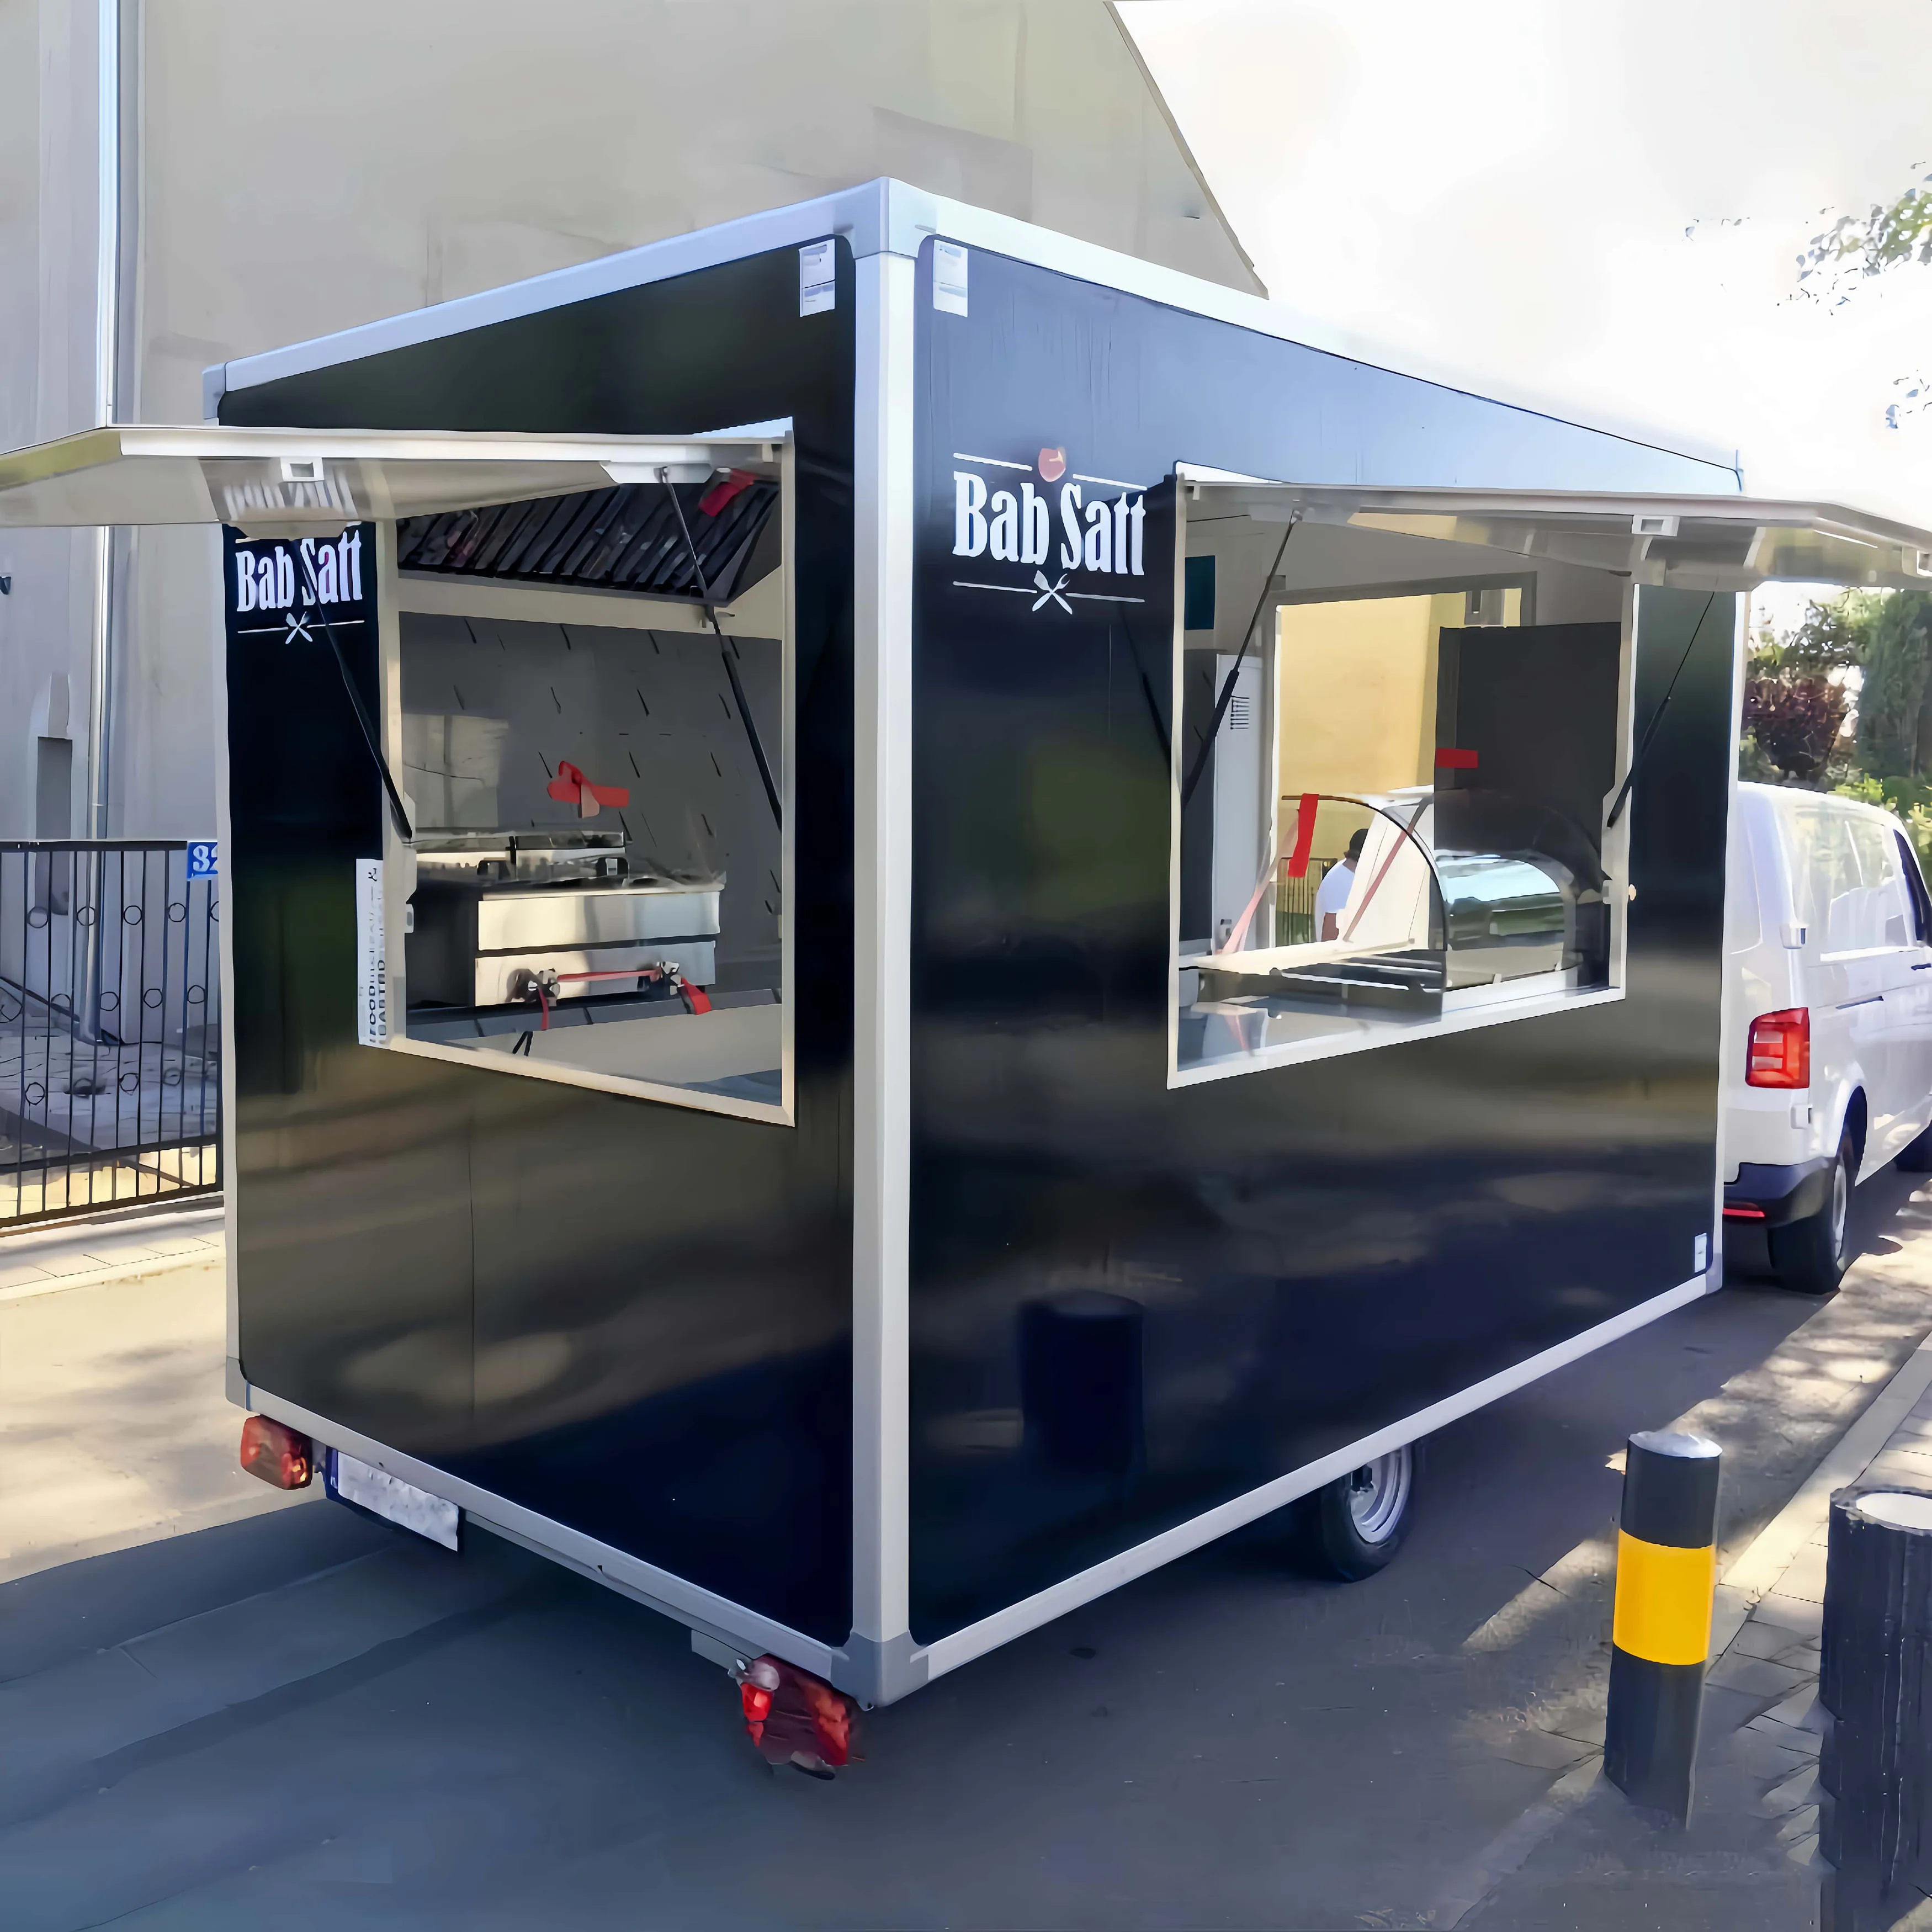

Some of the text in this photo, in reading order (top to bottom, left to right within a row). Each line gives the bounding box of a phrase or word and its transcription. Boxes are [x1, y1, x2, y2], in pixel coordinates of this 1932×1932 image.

[952, 471, 1146, 575] Bab Satt
[235, 529, 363, 612] Bab Satt
